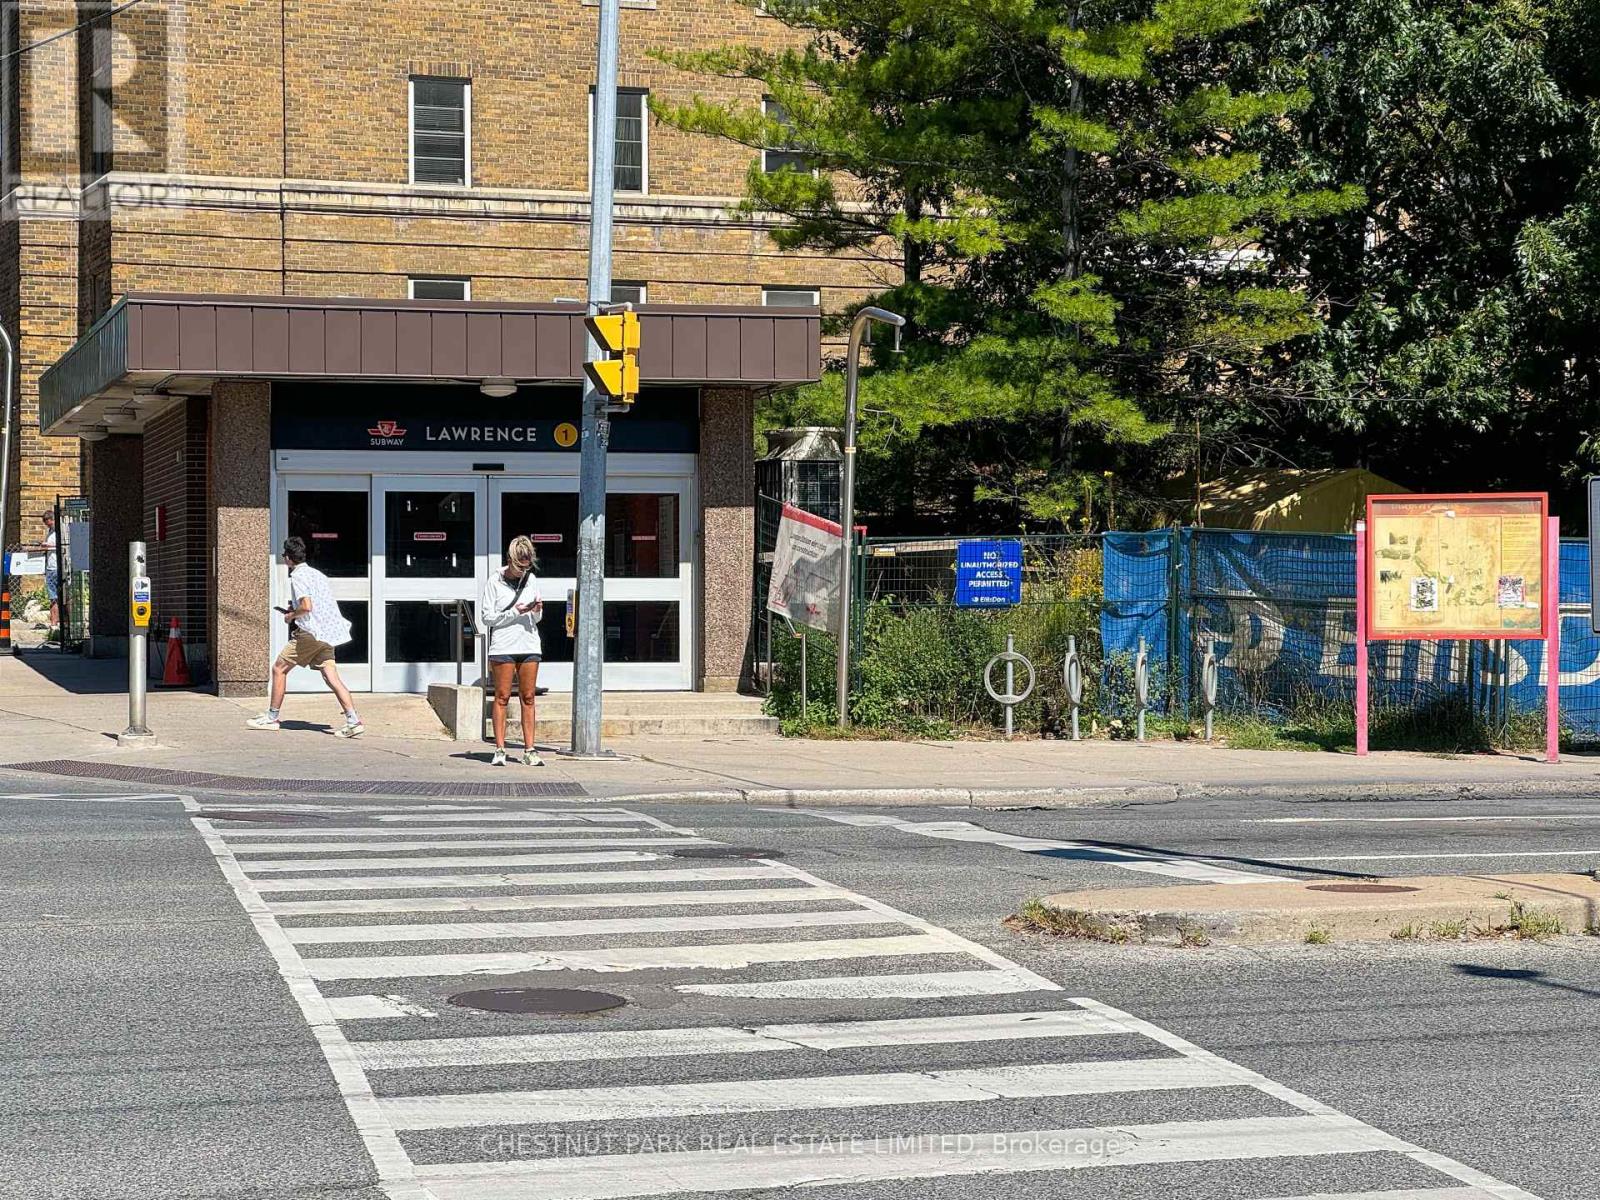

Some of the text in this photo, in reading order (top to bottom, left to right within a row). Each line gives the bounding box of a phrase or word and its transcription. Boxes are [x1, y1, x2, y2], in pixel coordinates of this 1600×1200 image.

[425, 426, 537, 443] LAWRENCE
[369, 438, 405, 447] SUBWAY
[983, 551, 997, 560] NO
[960, 561, 1019, 569] UNAUTHORIZED
[975, 571, 1003, 579] ACCESS
[968, 580, 1010, 588] PERMITTED
